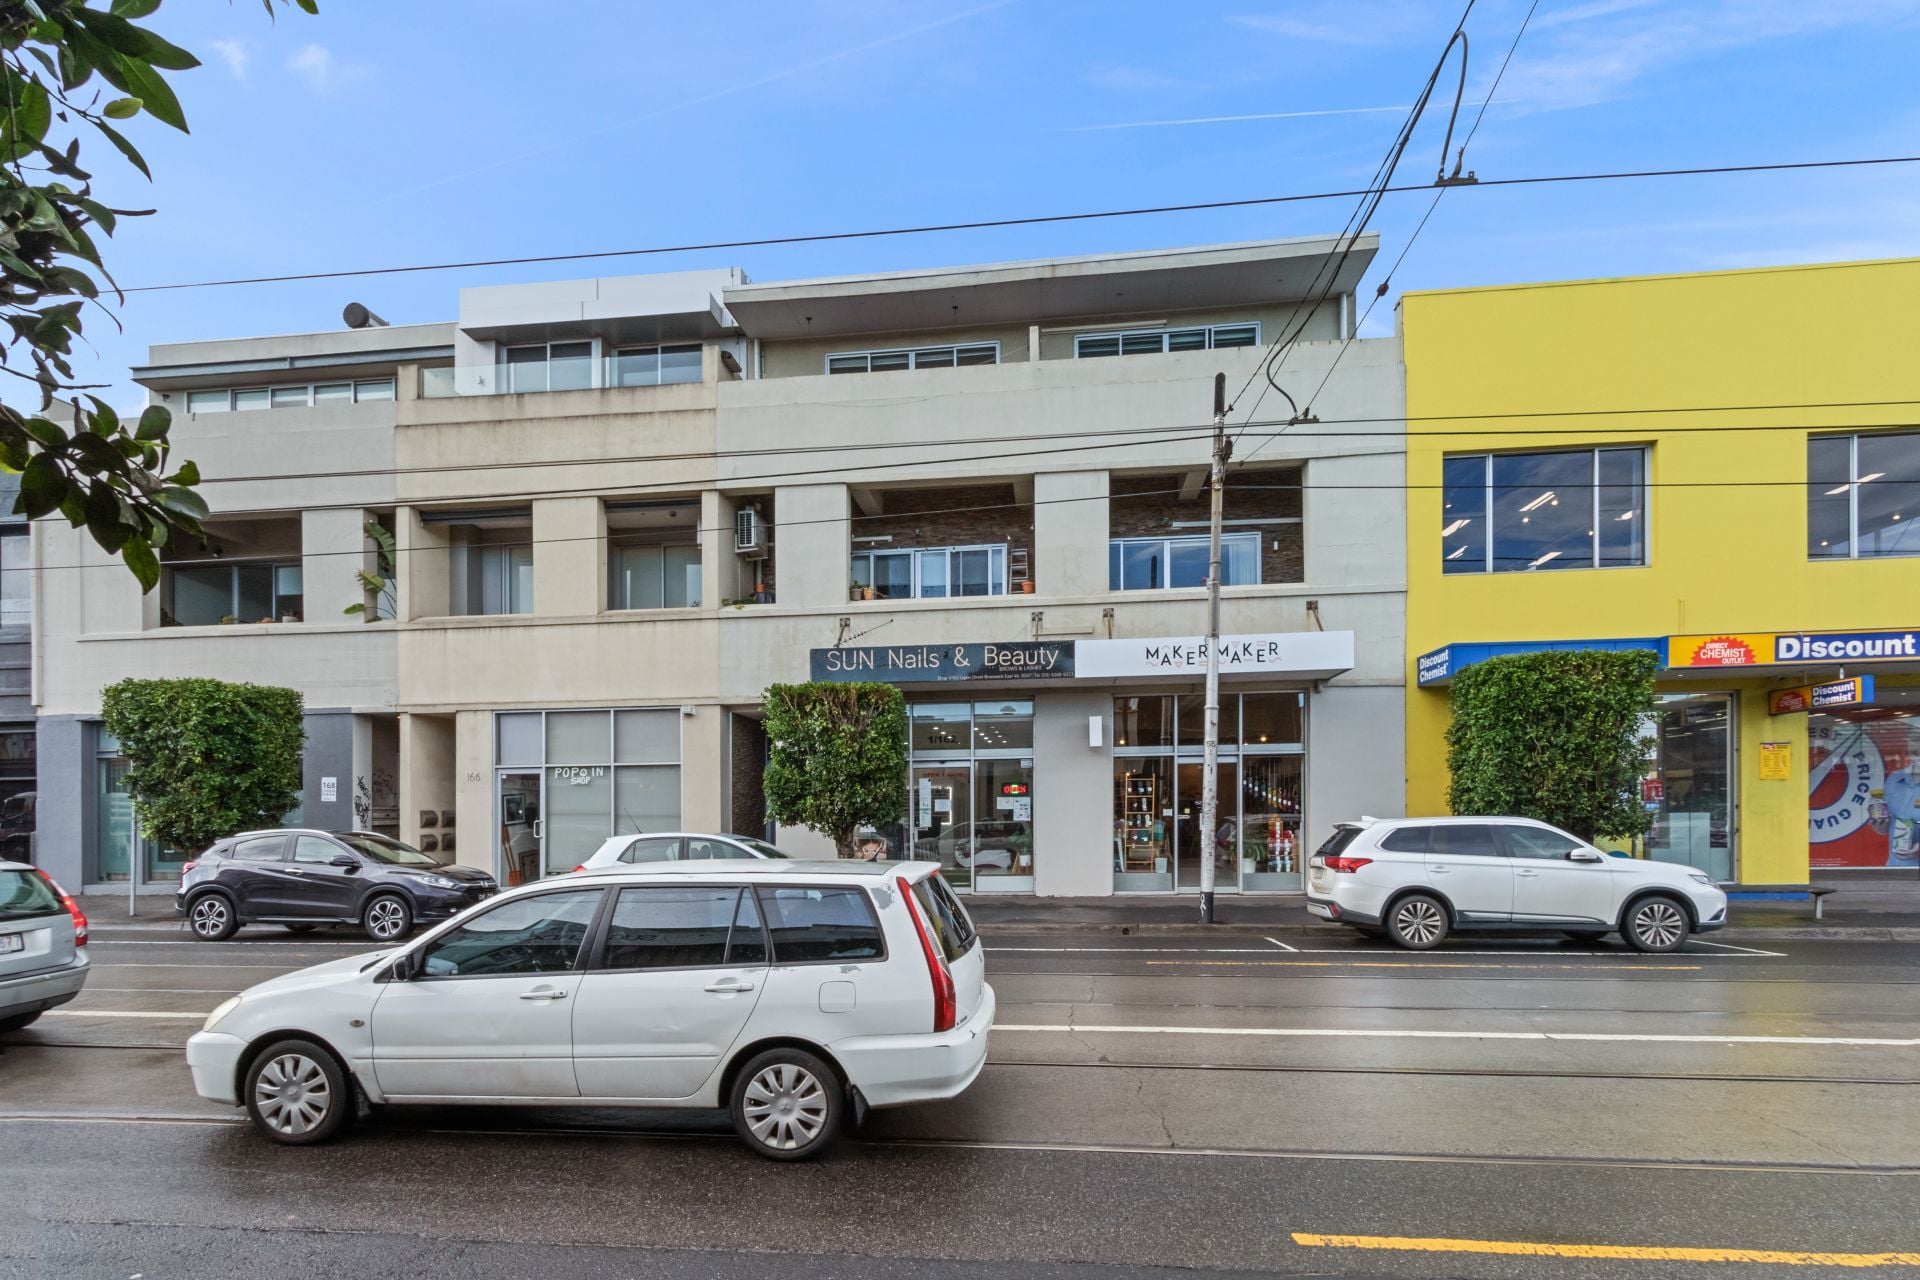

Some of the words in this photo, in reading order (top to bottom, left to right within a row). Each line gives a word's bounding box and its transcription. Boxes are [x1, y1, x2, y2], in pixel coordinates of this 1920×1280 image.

[1146, 645, 1208, 665] MAKER
[1218, 642, 1278, 663] MAKER
[1700, 648, 1745, 659] CHEMIST
[1779, 635, 1915, 658] Discount
[827, 649, 873, 671] SUN
[888, 647, 939, 669] Nails
[954, 646, 970, 667] &
[984, 645, 1058, 670] Beauty
[1420, 649, 1448, 670] Discount
[1420, 664, 1447, 682] Chemist
[1813, 682, 1854, 696] Discount
[1813, 693, 1852, 705] Chemist
[928, 735, 957, 744] 1/162
[467, 772, 481, 783] 166
[555, 768, 579, 778] POP
[592, 767, 604, 777] IN
[1851, 752, 1870, 806] PRICE
[571, 777, 591, 785] SHOP
[1003, 785, 1026, 793] OPEN
[1808, 808, 1851, 830] GUA
